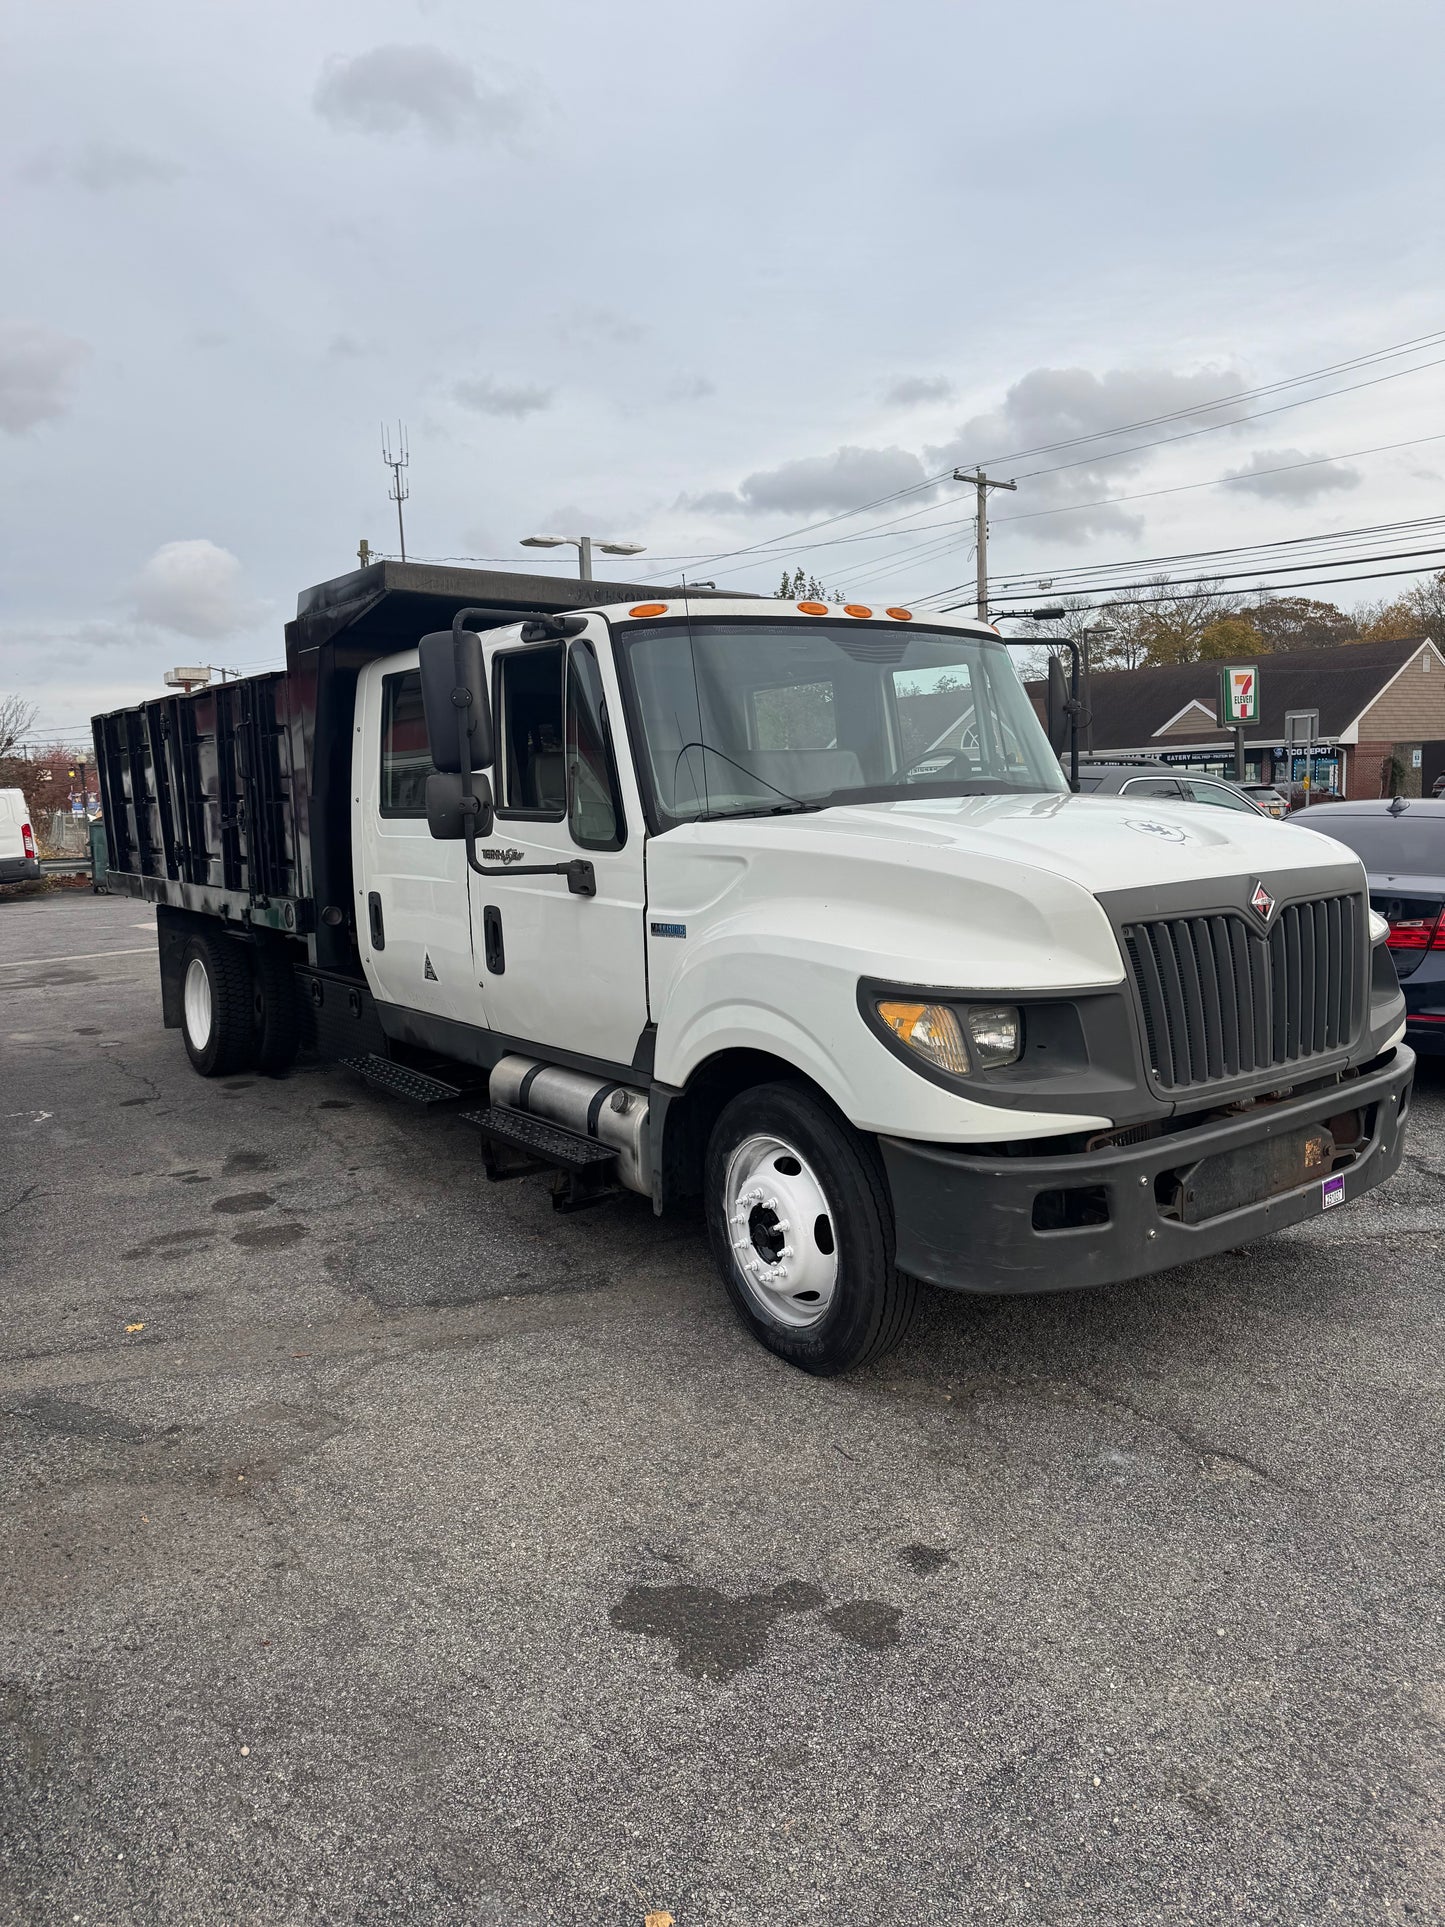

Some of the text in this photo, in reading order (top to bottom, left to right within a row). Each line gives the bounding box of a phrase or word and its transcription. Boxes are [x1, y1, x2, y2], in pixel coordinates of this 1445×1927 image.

[1234, 674, 1252, 718] 7
[1303, 747, 1332, 755] DEPOT
[1166, 754, 1191, 762] EATERY
